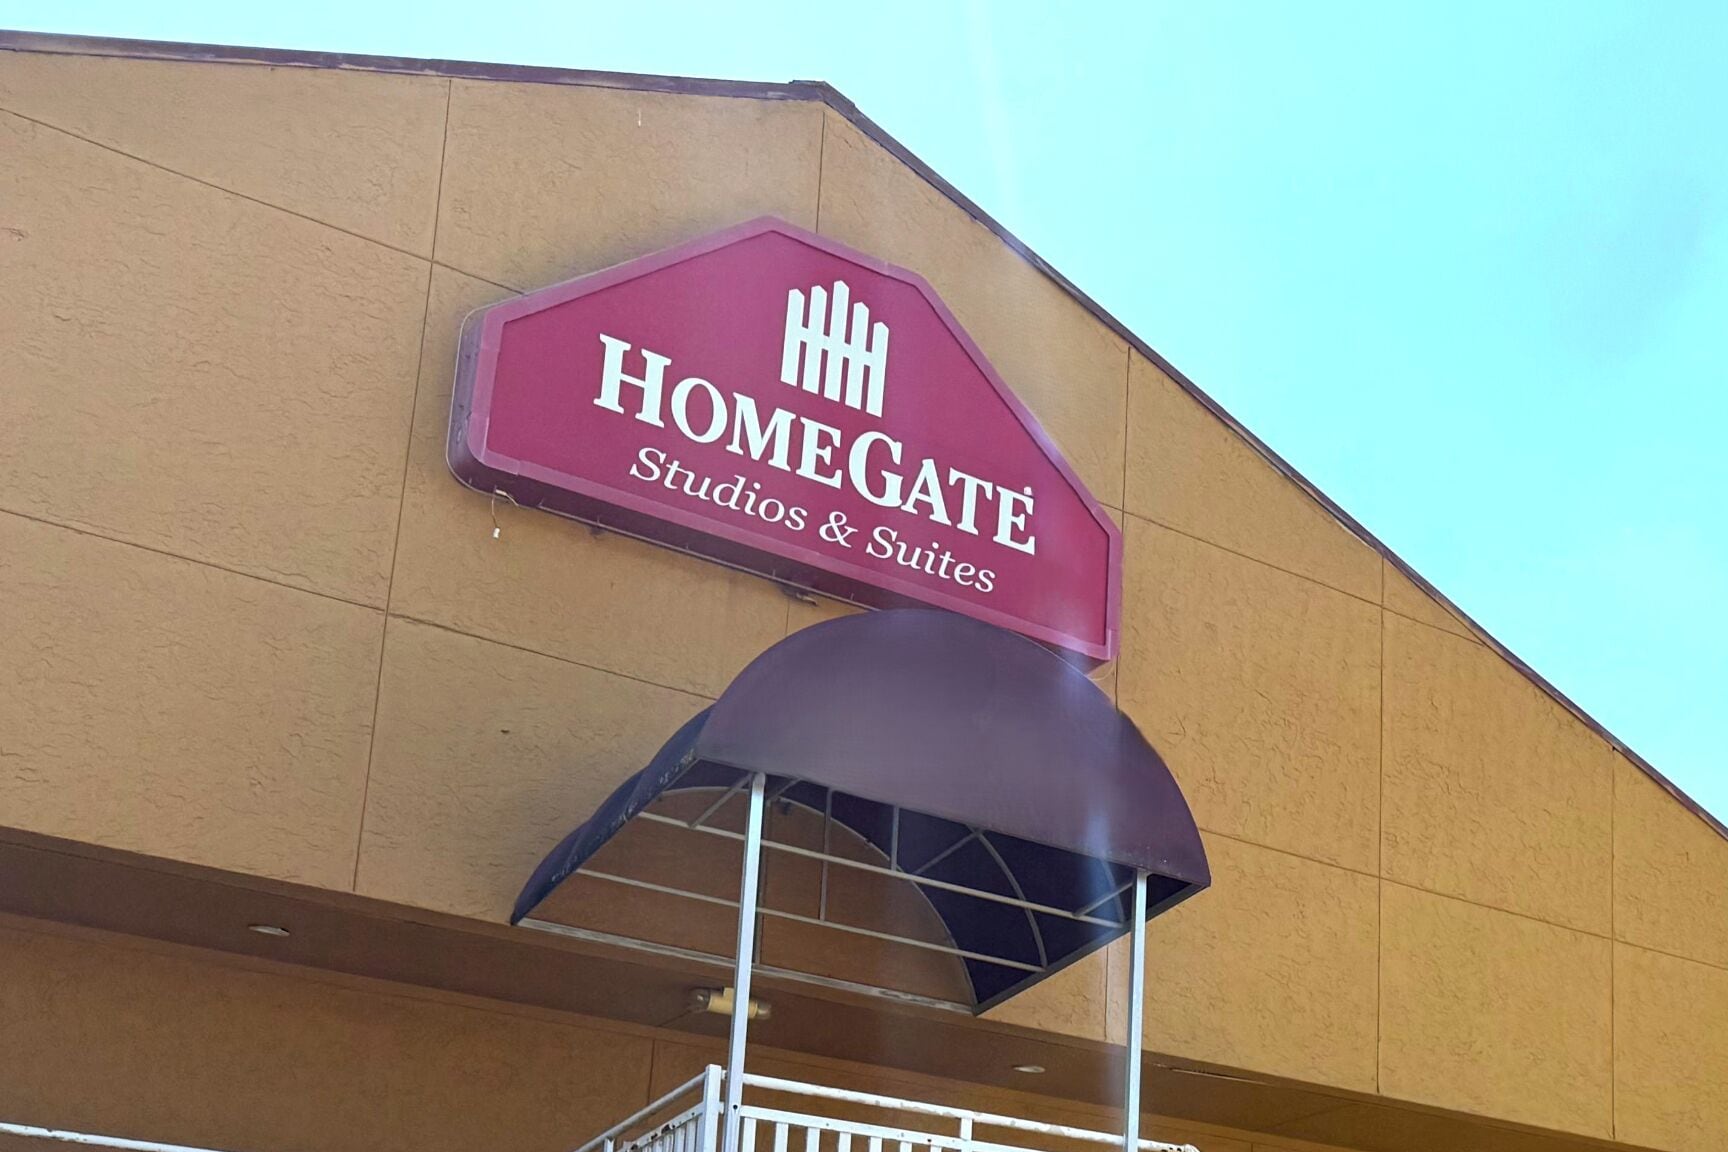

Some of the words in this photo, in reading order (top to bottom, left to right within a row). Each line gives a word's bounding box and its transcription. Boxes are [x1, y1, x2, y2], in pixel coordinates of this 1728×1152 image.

[593, 333, 1036, 555] HOMEGATE
[629, 447, 808, 531] Studios
[819, 511, 858, 549] &
[865, 526, 996, 594] Suites
